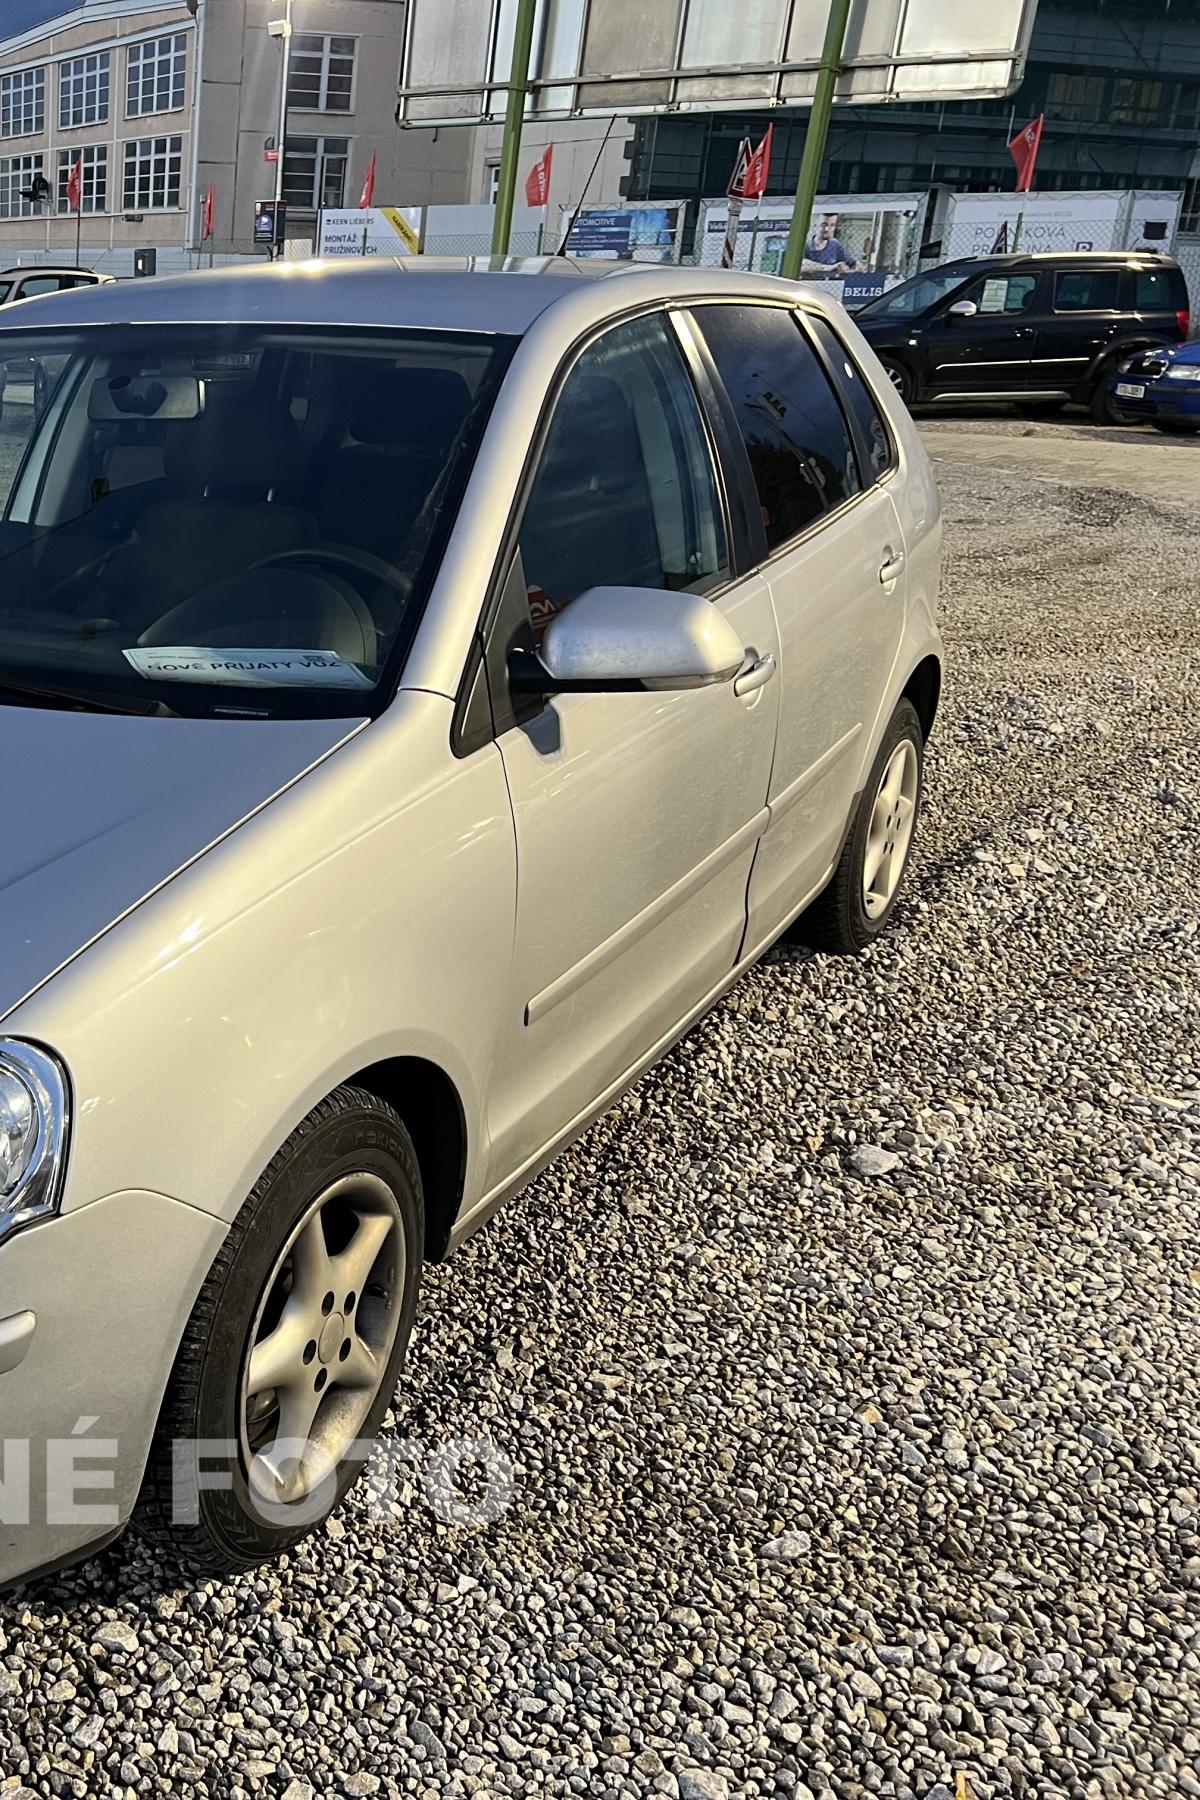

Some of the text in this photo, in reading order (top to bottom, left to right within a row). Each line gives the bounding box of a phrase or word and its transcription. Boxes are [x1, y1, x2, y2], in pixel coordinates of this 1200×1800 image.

[324, 233, 357, 243] MONTÁŽ
[324, 244, 377, 255] PRUŽINOVCH
[843, 287, 883, 297] BELIS
